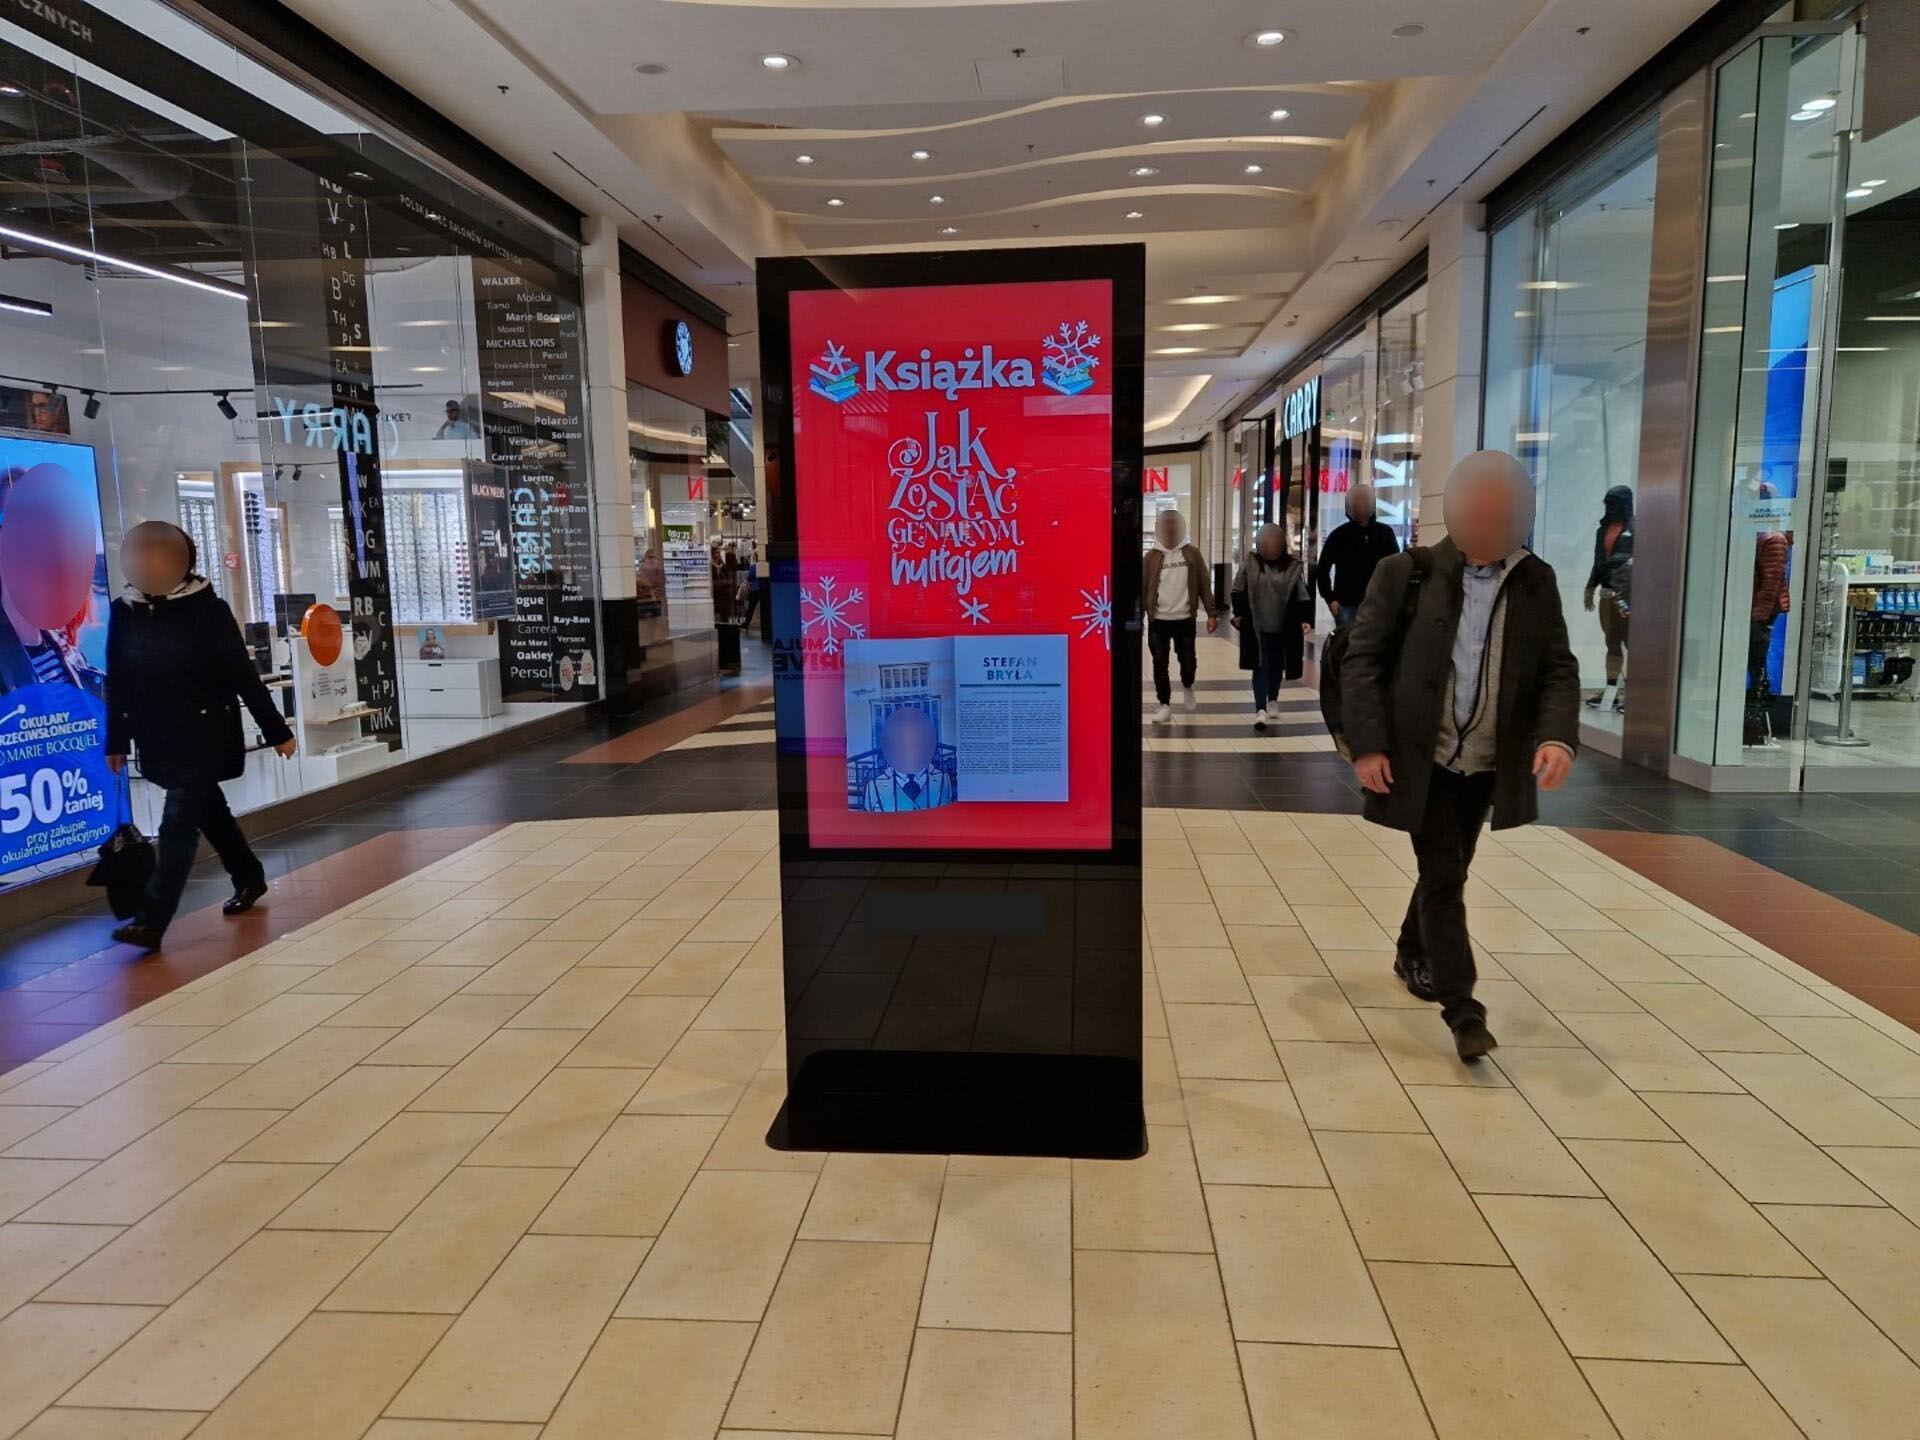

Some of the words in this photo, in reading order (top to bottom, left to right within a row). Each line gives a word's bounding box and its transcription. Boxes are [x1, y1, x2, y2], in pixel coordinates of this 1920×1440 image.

[331, 277, 343, 300] B
[481, 277, 521, 287] WALKER
[486, 339, 528, 349] MICHAEL
[529, 338, 556, 348] KORS
[866, 345, 1036, 400] Książka
[1284, 375, 1318, 440] CARRY
[891, 548, 1018, 594] hultajem
[354, 596, 375, 617] RB
[516, 596, 545, 607] ogue
[508, 614, 544, 622] ALKER
[553, 616, 590, 625] Ray-Ban
[516, 651, 553, 662] Oakley
[983, 656, 1037, 668] STEFAN
[510, 666, 553, 679] Persol
[987, 670, 1033, 681] BRYŁA
[20, 712, 70, 730] OKULARY
[7, 743, 44, 764] MARIE
[46, 734, 100, 756] BOCQUEL
[64, 790, 104, 815] taniej
[26, 831, 49, 848] przy
[50, 820, 87, 839] zakupie
[2, 842, 49, 864] okularów
[50, 825, 111, 850] korekcyjnych
